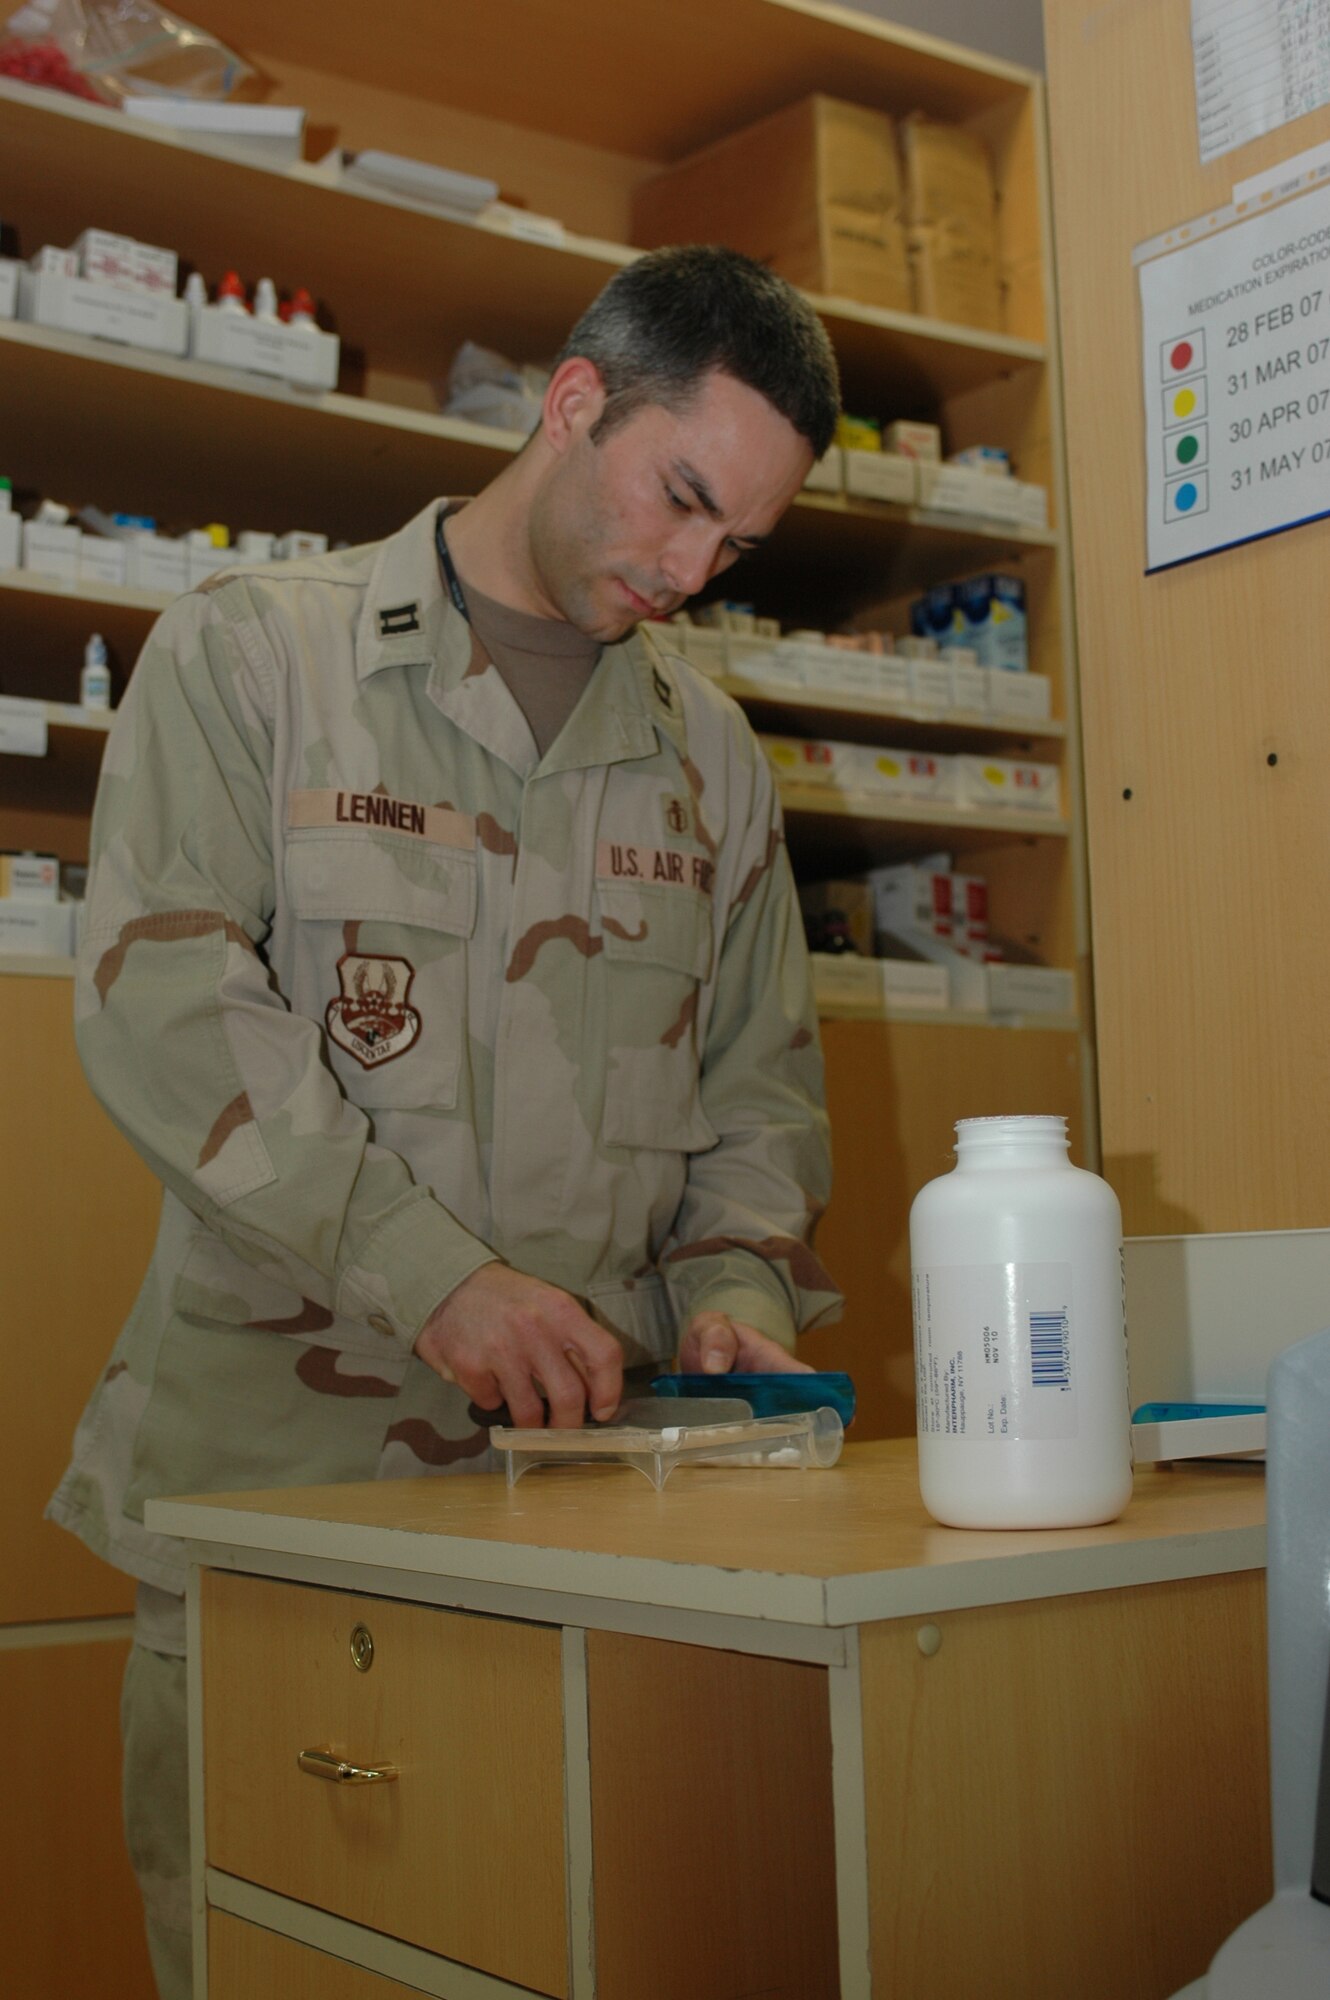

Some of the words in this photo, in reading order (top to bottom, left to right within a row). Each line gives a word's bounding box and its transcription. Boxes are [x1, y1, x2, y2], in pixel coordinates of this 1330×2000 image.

[1188, 277, 1262, 316] MEDICATION
[1265, 245, 1330, 285] EXPIRATIO
[1226, 321, 1249, 348] 28
[1255, 303, 1294, 337] FEB
[1300, 290, 1322, 317] 07
[1227, 371, 1248, 396] 31
[1256, 350, 1302, 385] MAR
[1307, 338, 1330, 365] 07
[1229, 418, 1252, 444] 30
[1257, 399, 1302, 434] APR
[1307, 389, 1330, 416] 07
[1231, 467, 1252, 492] 31
[1260, 446, 1306, 483] MAY
[336, 792, 426, 836] LENNEN
[611, 845, 644, 878] U.S.
[654, 851, 684, 883] AIR
[991, 1331, 998, 1341] 10
[958, 1376, 964, 1387] NY
[1000, 1416, 1008, 1434] Exp.
